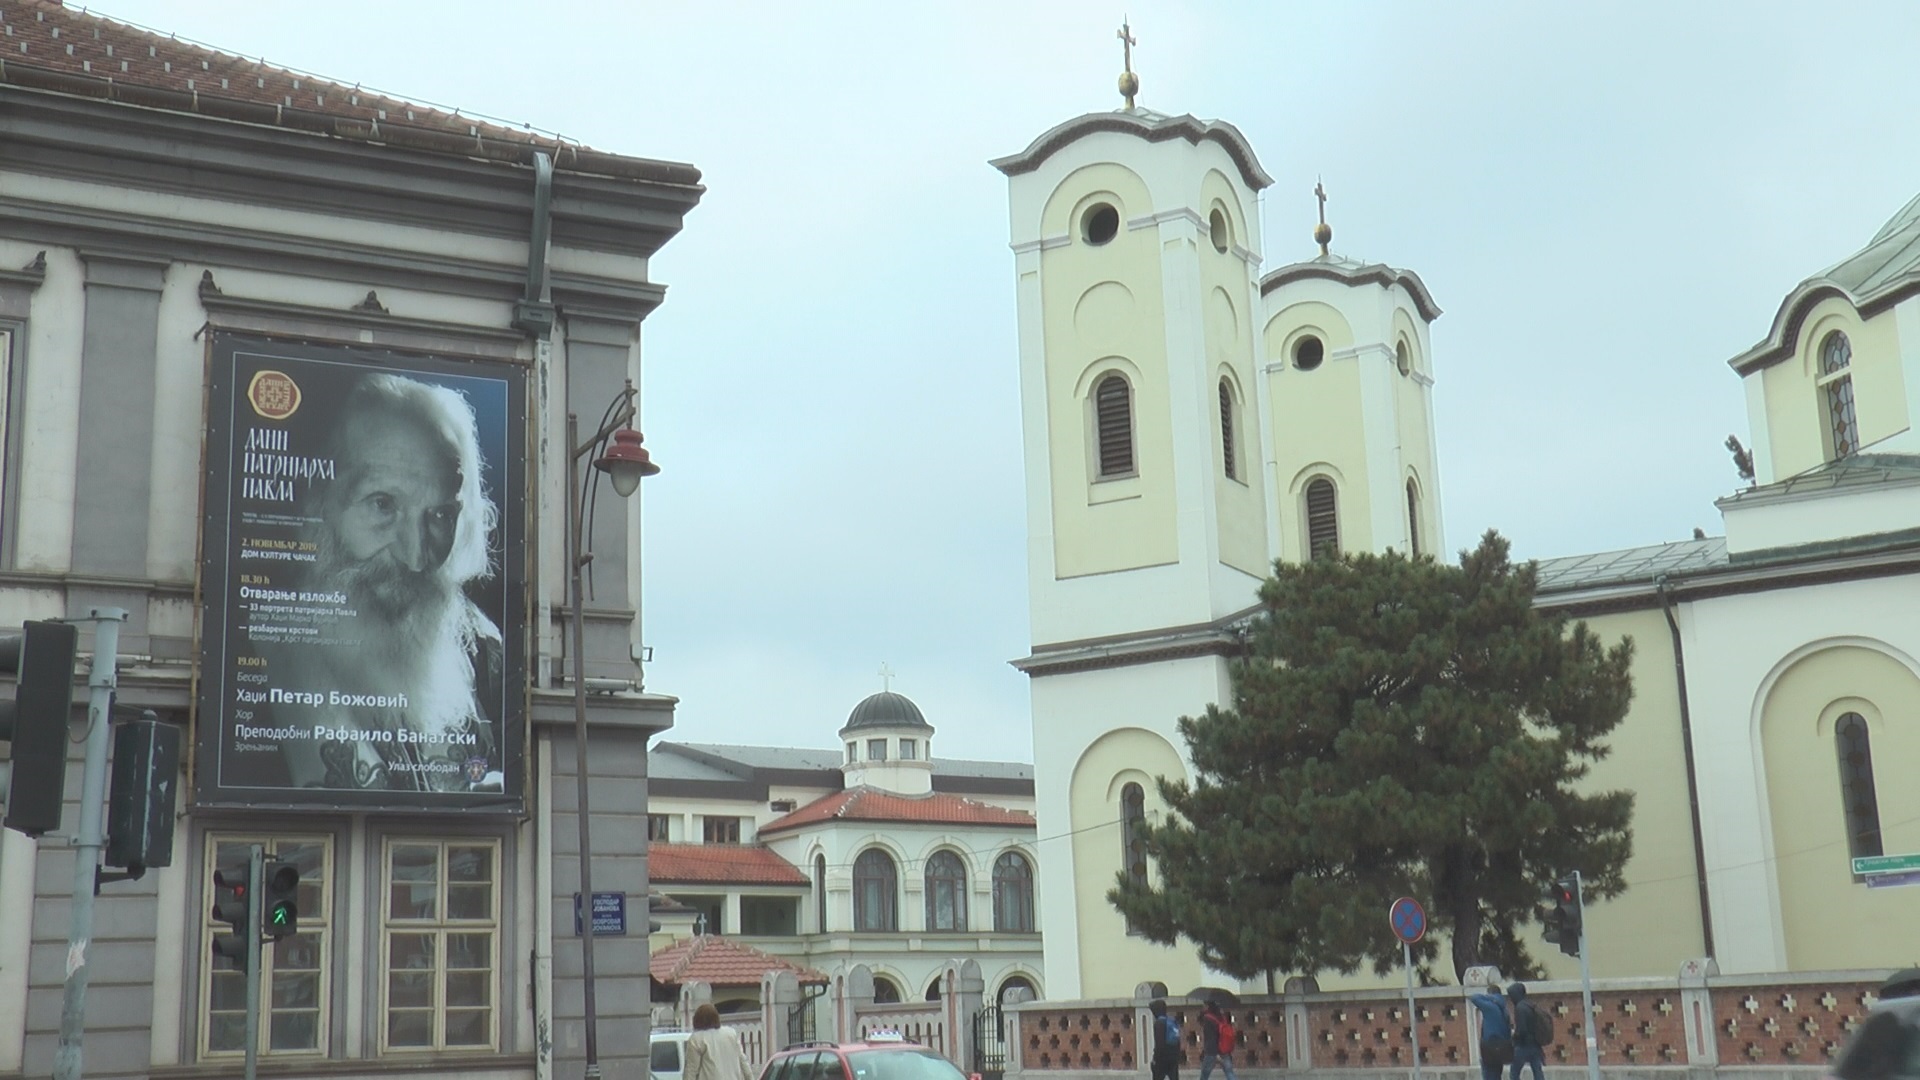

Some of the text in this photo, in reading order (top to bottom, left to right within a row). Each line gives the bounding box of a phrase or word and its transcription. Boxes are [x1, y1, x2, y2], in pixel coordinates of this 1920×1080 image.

[241, 550, 317, 562] ДОМ КУЛТУРЕ ЧАЧАК
[240, 586, 347, 604] Отварање изложбе
[249, 602, 258, 611] 33
[260, 604, 293, 614] портрета
[335, 607, 357, 617] Павла
[249, 623, 288, 635] резбарени
[289, 626, 318, 636] крстови
[238, 656, 267, 666] 19.00 h
[237, 671, 268, 685] Беседа
[236, 688, 408, 708] Хаџи Петар Божовић
[235, 709, 254, 721] Хор
[235, 724, 477, 745] Преподобни Рафаило Банатски
[234, 741, 279, 753] Зрењанин
[388, 760, 460, 773] Улаз слободан
